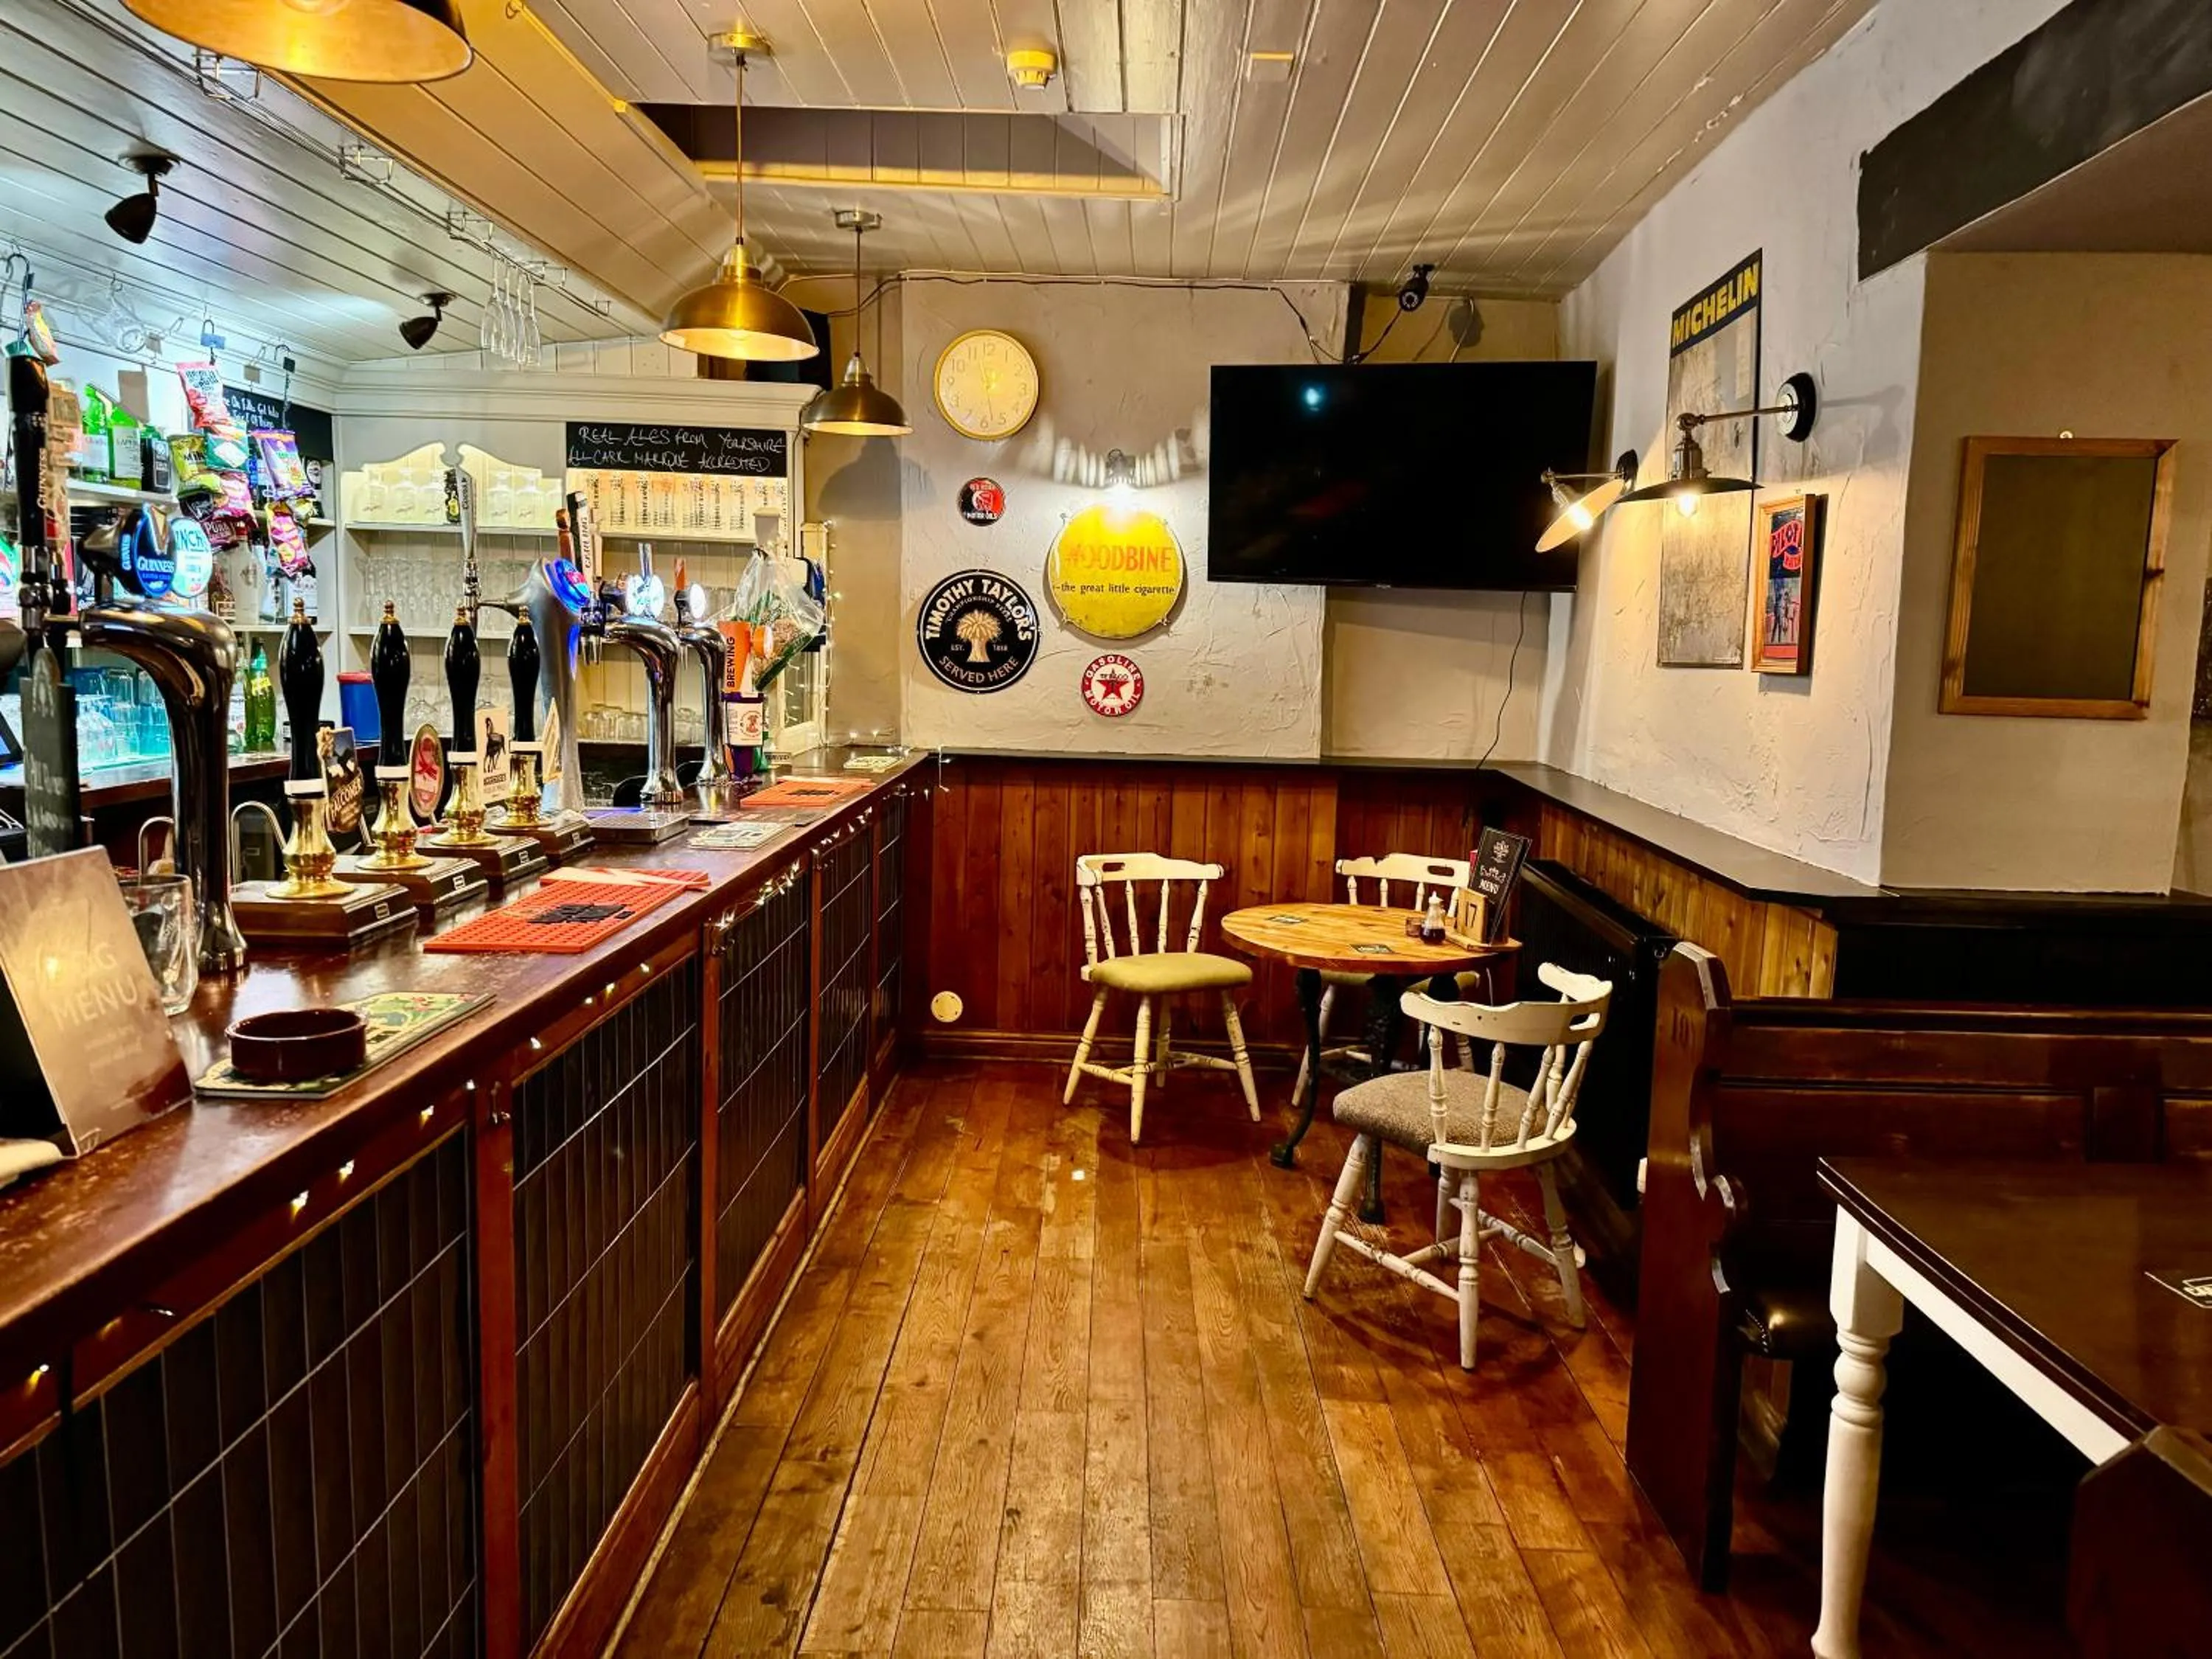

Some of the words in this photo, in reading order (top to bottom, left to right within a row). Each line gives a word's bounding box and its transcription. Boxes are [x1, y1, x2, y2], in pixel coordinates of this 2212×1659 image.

[1672, 261, 1759, 349] MICHELIN
[579, 425, 623, 444] REAL
[622, 427, 671, 446] ALES
[633, 451, 689, 472] MARQUE
[37, 448, 49, 509] GUINNESS
[582, 516, 591, 569] CARLING
[138, 556, 175, 574] GUINNESS
[1080, 583, 1105, 595] great
[1108, 582, 1130, 594] little
[1133, 585, 1175, 596] cigarette
[925, 579, 975, 639] TIMOTHY
[981, 579, 1036, 641] TAYLOR'S
[726, 636, 736, 688] BREWING
[939, 655, 985, 684] SERVED
[987, 655, 1019, 682] HERE
[1086, 655, 1141, 680] GASOLINE
[1085, 690, 1122, 714] MOTOR
[1124, 694, 1140, 709] OIL
[1478, 879, 1500, 894] MENU
[48, 973, 139, 1031] MENU
